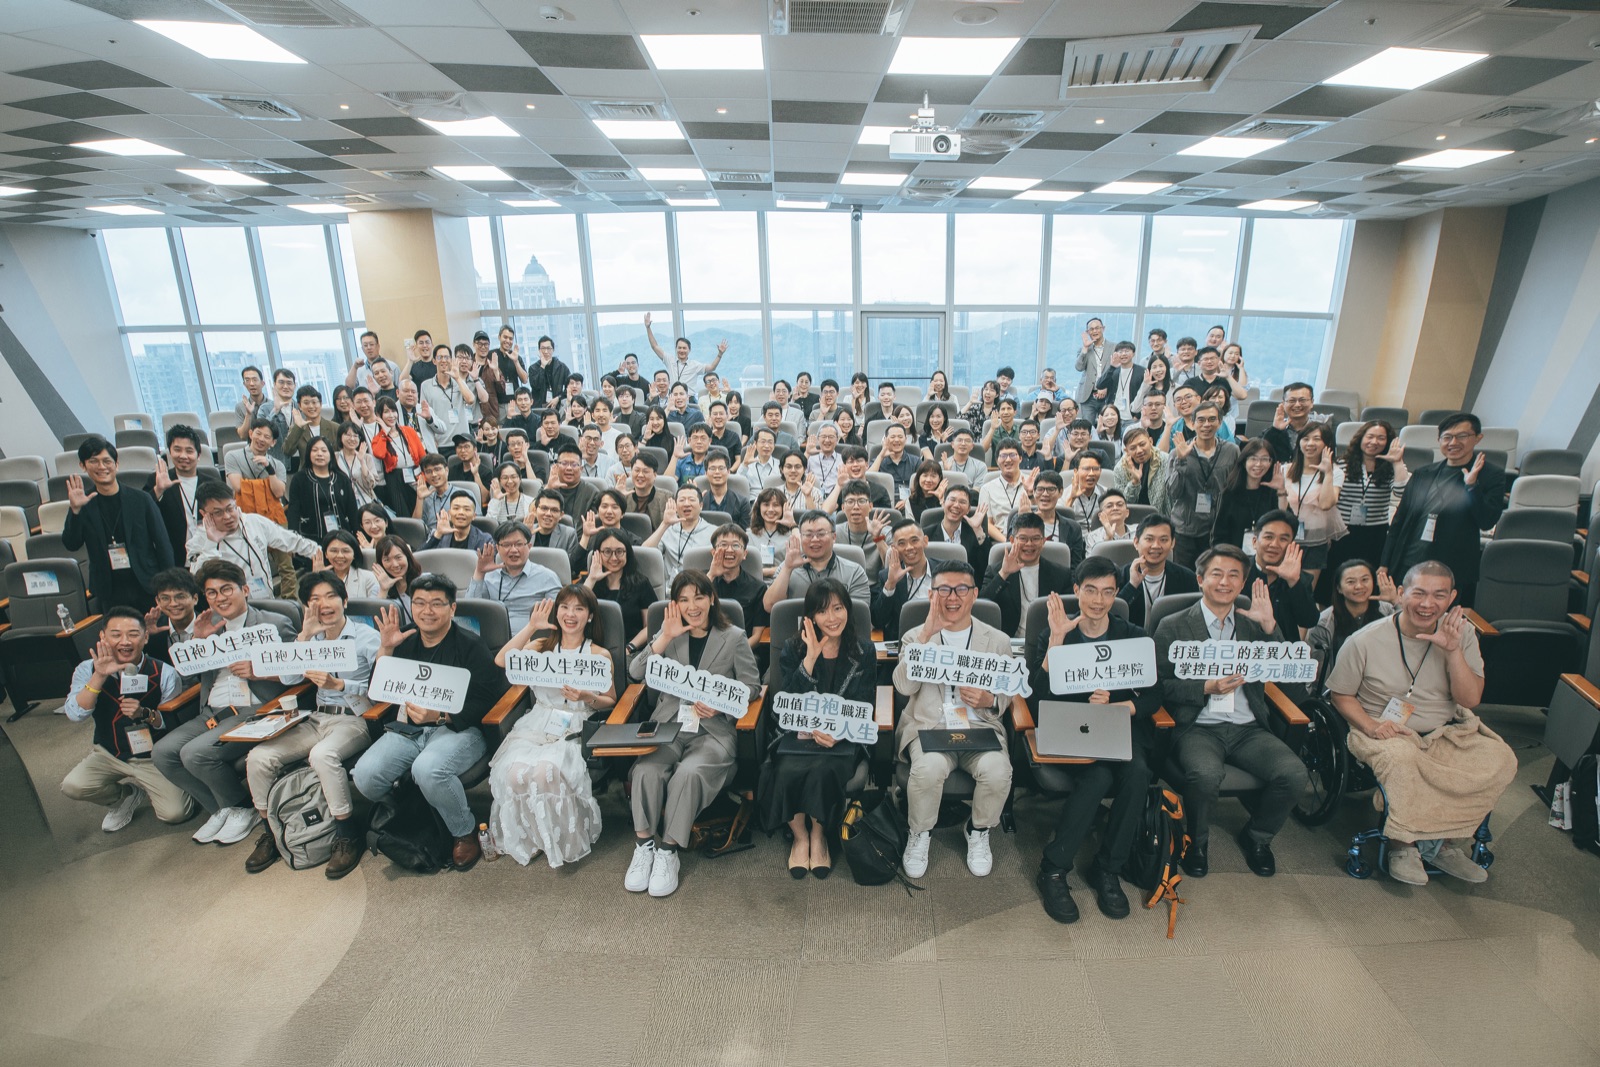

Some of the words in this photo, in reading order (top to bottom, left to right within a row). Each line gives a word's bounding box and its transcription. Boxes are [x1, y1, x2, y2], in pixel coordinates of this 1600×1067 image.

[174, 628, 277, 664] 白袍人生學院
[260, 646, 347, 664] 白袍人生學院
[1172, 643, 1308, 661] 打造自己的差異人生
[181, 663, 206, 673] White
[207, 658, 225, 667] Coat
[227, 654, 243, 663] Life
[509, 654, 607, 678] 白袍人生學院
[908, 646, 1025, 676] 當自己職涯的主人
[1064, 662, 1144, 683] 白袍人生學院
[1178, 662, 1315, 680] 掌控自己的多元職涯
[383, 679, 455, 702] 白袍人生學院
[510, 673, 534, 681] White
[555, 676, 570, 684] Life
[571, 679, 608, 689] Academy
[650, 660, 745, 705] 白袍人生學院
[911, 664, 1028, 695] 當別人生命的貴人
[1116, 679, 1145, 687] Academy
[649, 677, 671, 689] White
[672, 685, 690, 697] Coat
[691, 691, 706, 701] Life
[707, 698, 743, 715] Academy
[775, 694, 869, 720] 加值白袍職涯
[781, 712, 875, 742] 斜槓多元人生
